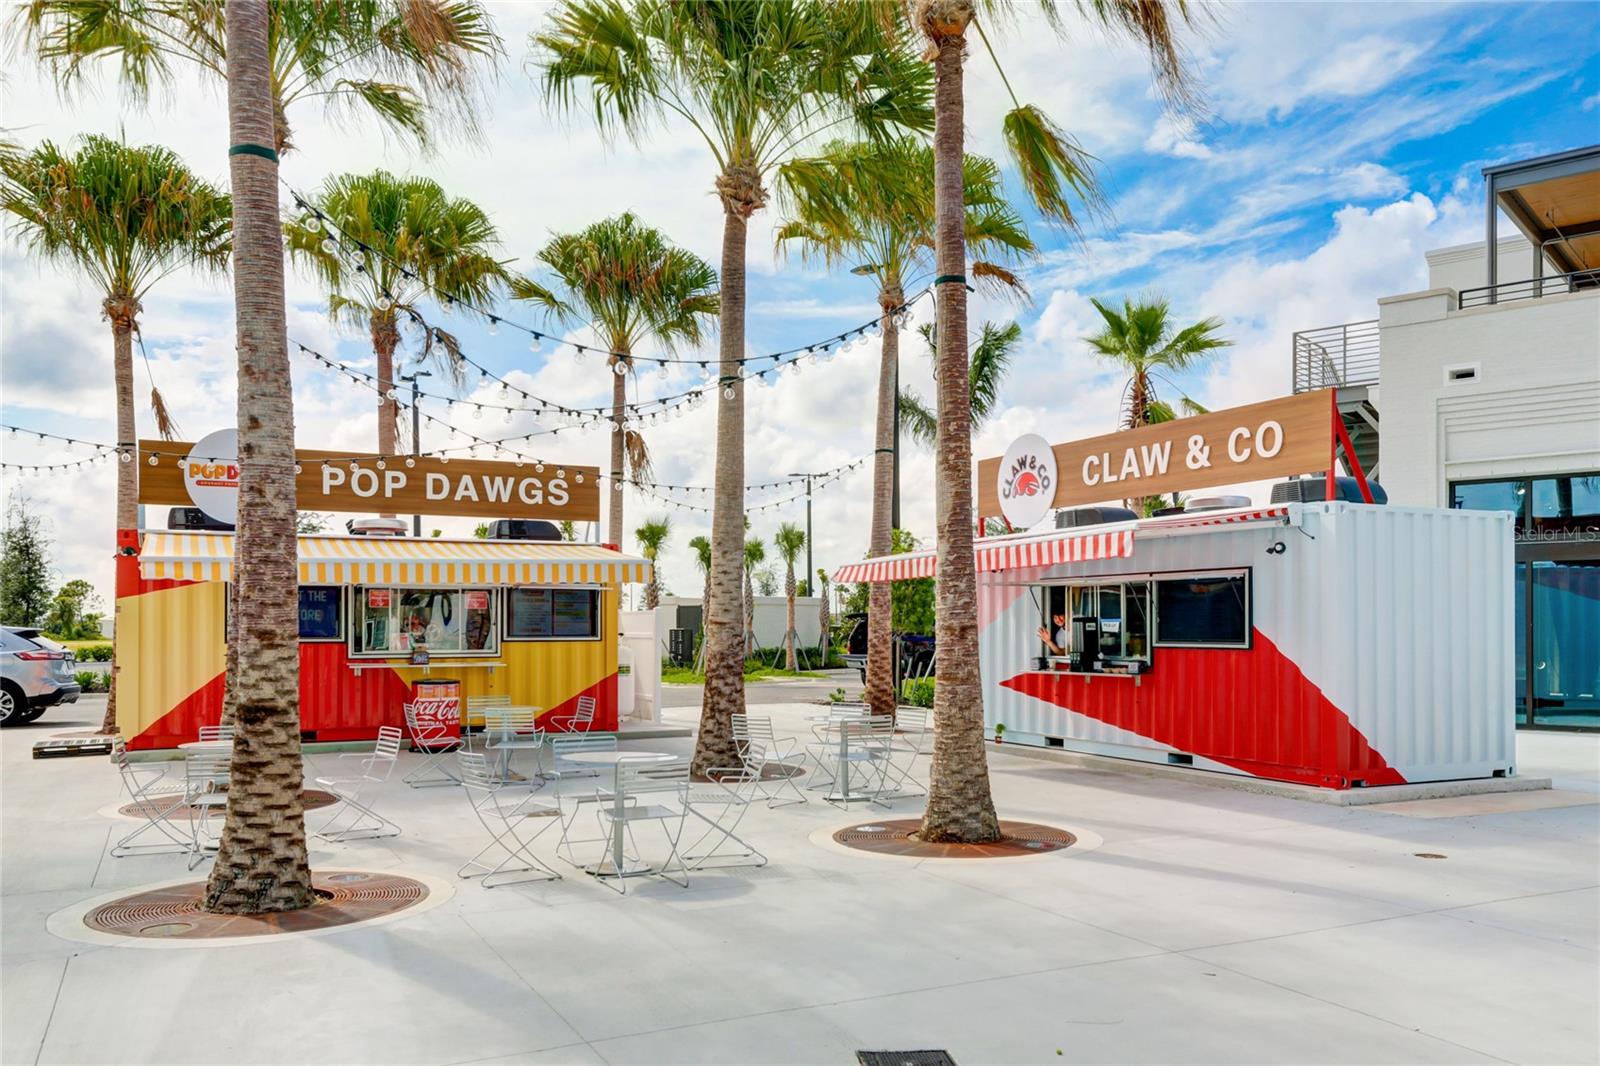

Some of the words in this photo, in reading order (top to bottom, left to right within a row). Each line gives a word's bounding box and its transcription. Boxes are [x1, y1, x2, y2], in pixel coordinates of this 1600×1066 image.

[1082, 440, 1173, 487] CLAW
[1185, 434, 1212, 470] &
[1228, 420, 1284, 463] CO
[322, 467, 407, 498] POP
[426, 472, 570, 506] DAWGS
[308, 590, 328, 602] THE
